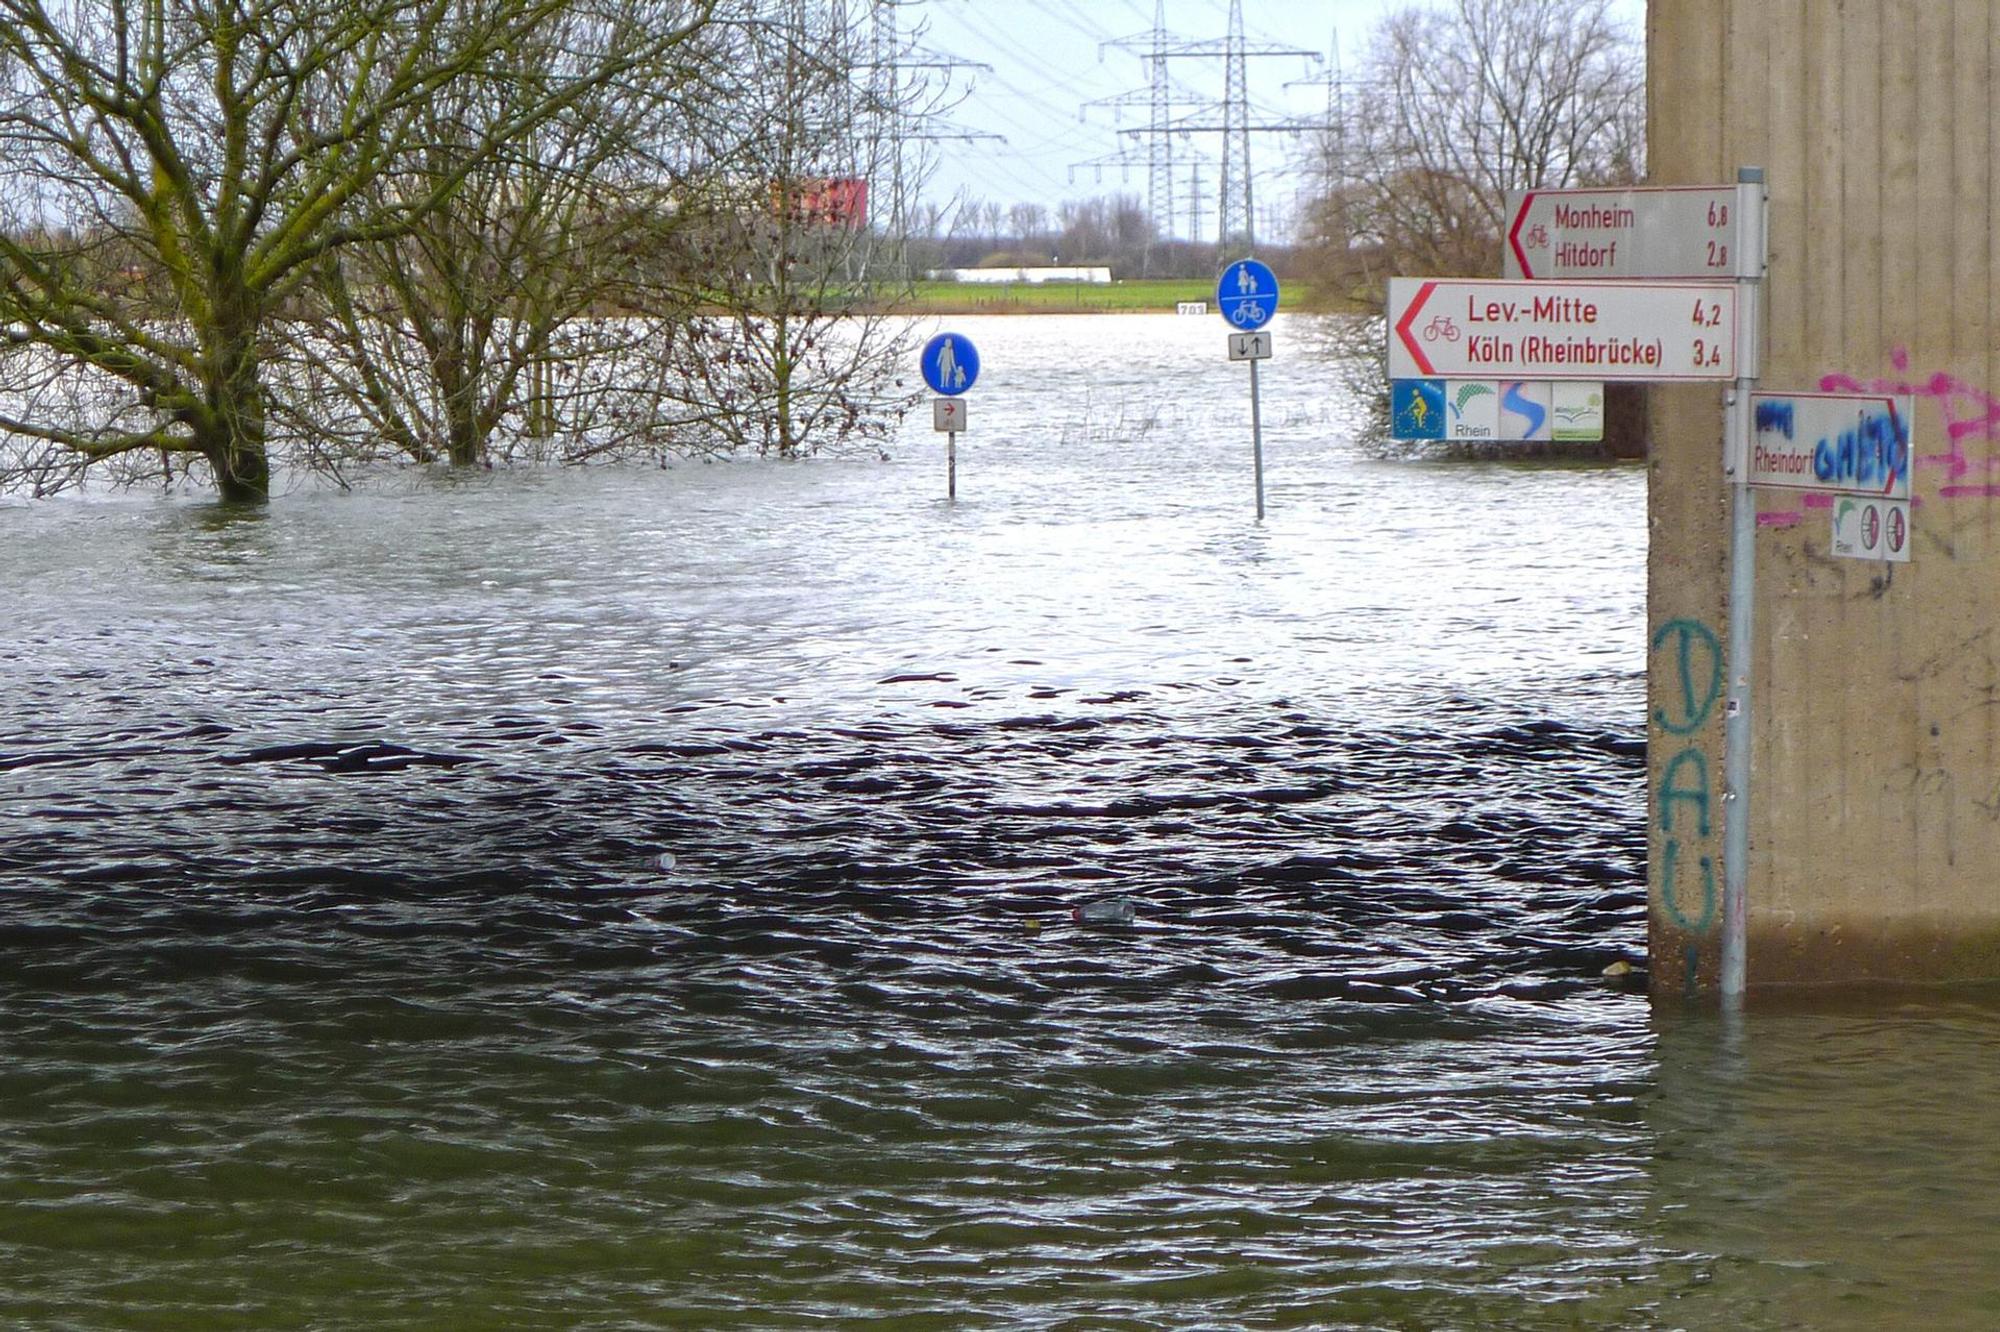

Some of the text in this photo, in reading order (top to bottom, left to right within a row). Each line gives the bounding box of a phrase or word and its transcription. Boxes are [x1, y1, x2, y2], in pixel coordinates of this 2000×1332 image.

[1554, 201, 1728, 229] Monheim 6,8
[1554, 241, 1728, 268] Hitdorf 2,8
[1468, 295, 1721, 328] Lev.-Mitte 4,2
[1467, 335, 1721, 368] Köln (Rheinbrücke) 3,4
[1455, 424, 1491, 437] Rhein
[1754, 445, 1815, 475] Rheindorf
